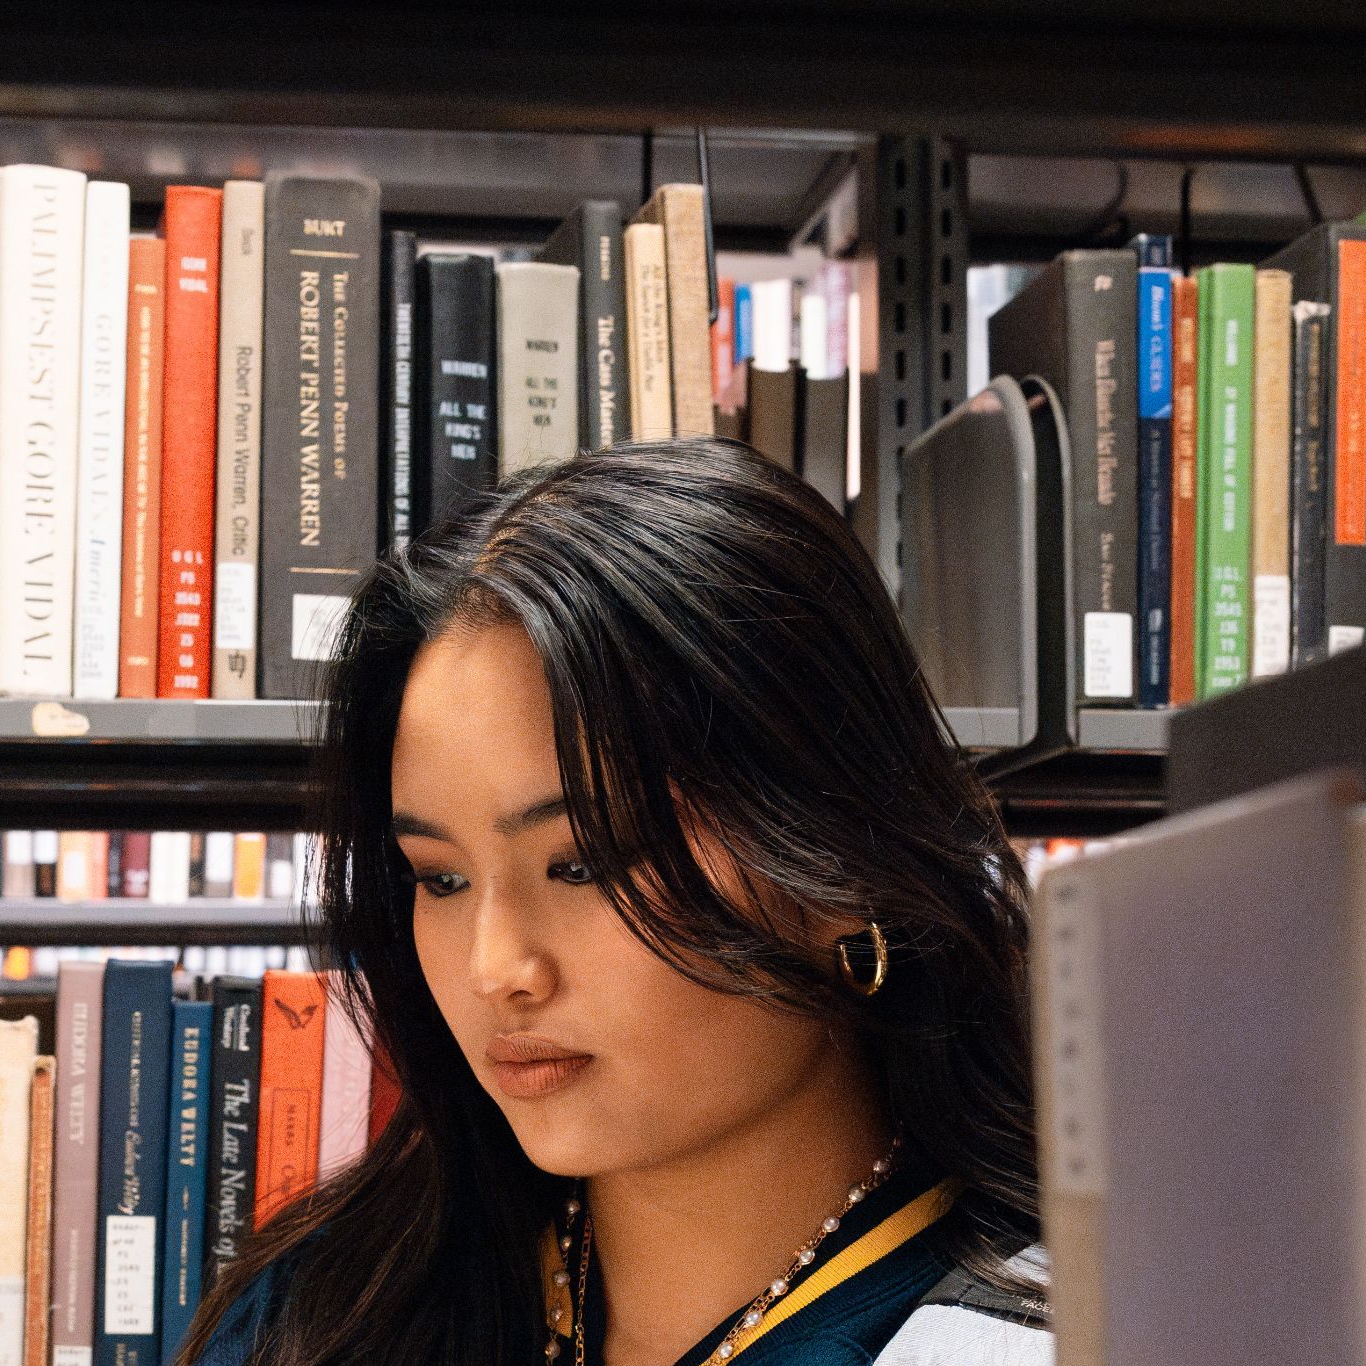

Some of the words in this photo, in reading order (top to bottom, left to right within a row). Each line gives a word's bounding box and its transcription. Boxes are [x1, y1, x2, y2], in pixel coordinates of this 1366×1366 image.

[28, 183, 59, 409] PALIMPSEST
[299, 271, 321, 368] ROBERT
[91, 313, 113, 398] GORE
[526, 340, 559, 353] WARREN
[597, 315, 615, 347] The
[235, 346, 253, 398] Robert
[441, 360, 488, 379] WARREN
[234, 402, 252, 443] Penn
[299, 372, 321, 438] PENN
[439, 401, 461, 417] ALL
[466, 403, 487, 420] THE
[444, 422, 481, 440] KING'S
[24, 421, 56, 534] GORE
[451, 443, 477, 460] MEN
[299, 443, 321, 547] WARREN
[232, 515, 249, 556] Critic
[22, 553, 55, 676] VIDAL
[71, 1002, 89, 1076] EUDORA
[183, 1027, 200, 1101] EUDORA
[69, 1082, 87, 1145] WELTY
[223, 1079, 250, 1116] The
[180, 1107, 198, 1167] WELTY
[221, 1120, 249, 1164] Late
[218, 1166, 247, 1233] Novels
[211, 1237, 238, 1258] of
